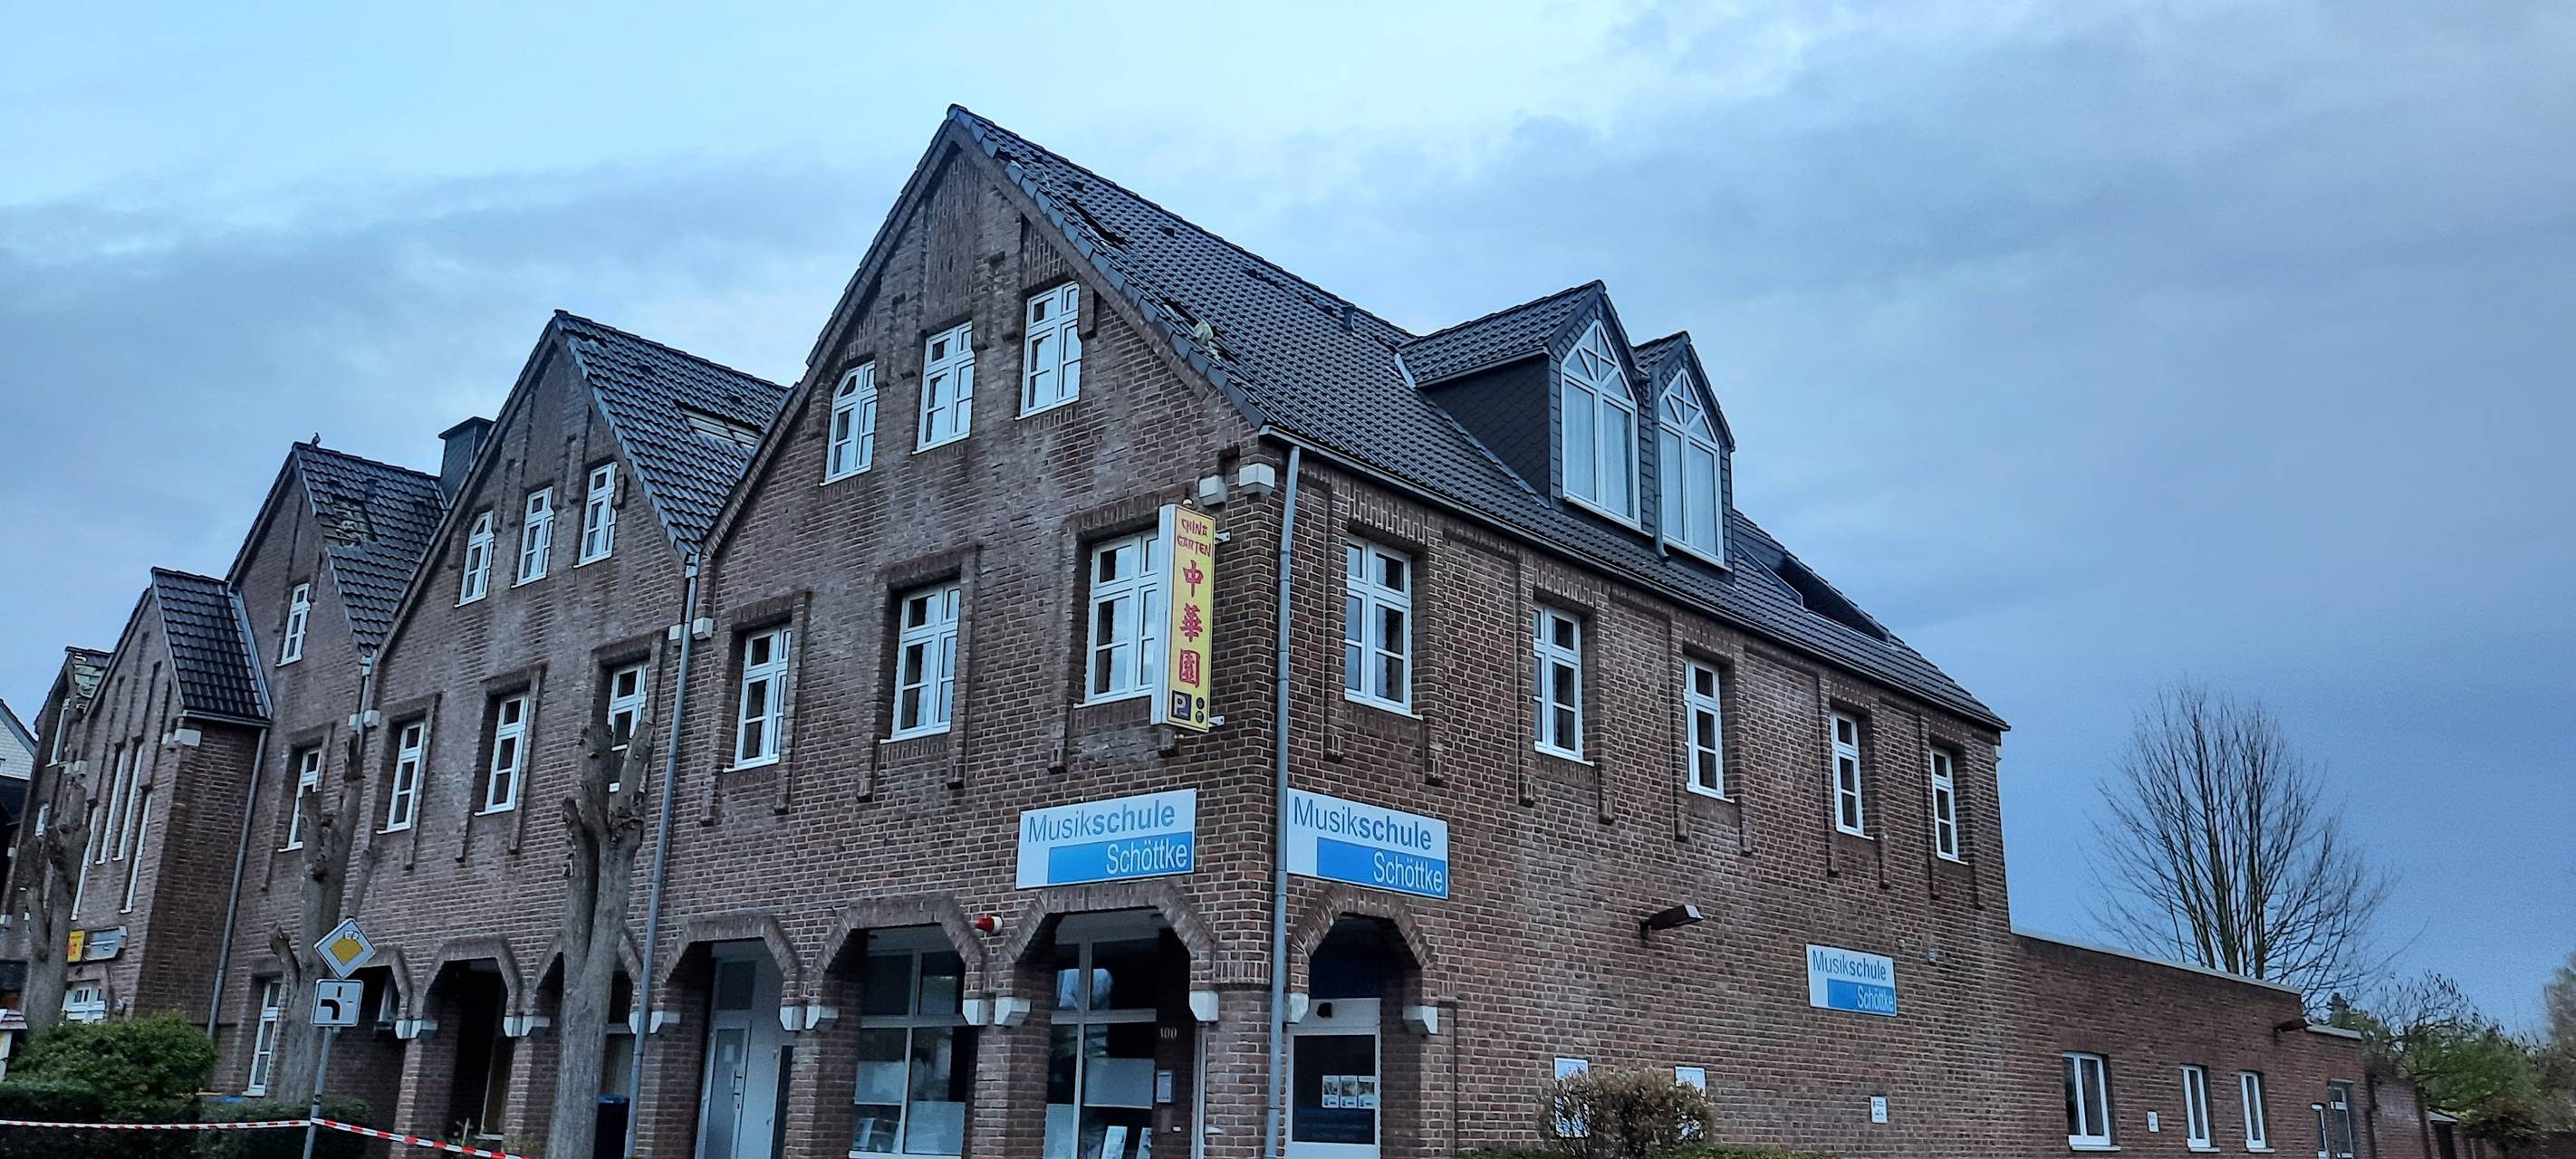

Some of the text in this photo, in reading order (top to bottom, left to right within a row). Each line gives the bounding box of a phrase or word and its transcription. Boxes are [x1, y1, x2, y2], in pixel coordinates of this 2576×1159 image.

[1181, 518, 1208, 537] CHINA
[1177, 535, 1211, 558] GARTEN
[1179, 560, 1204, 688] 中華園
[1028, 800, 1175, 843] Musikschule
[1294, 796, 1431, 850] Musikschule
[1106, 838, 1187, 875] Schöttke
[1373, 851, 1443, 892] Schöttke
[1812, 950, 1886, 981] Musikschule
[1857, 984, 1894, 1012] Schöttke
[1160, 1028, 1177, 1039] 100
